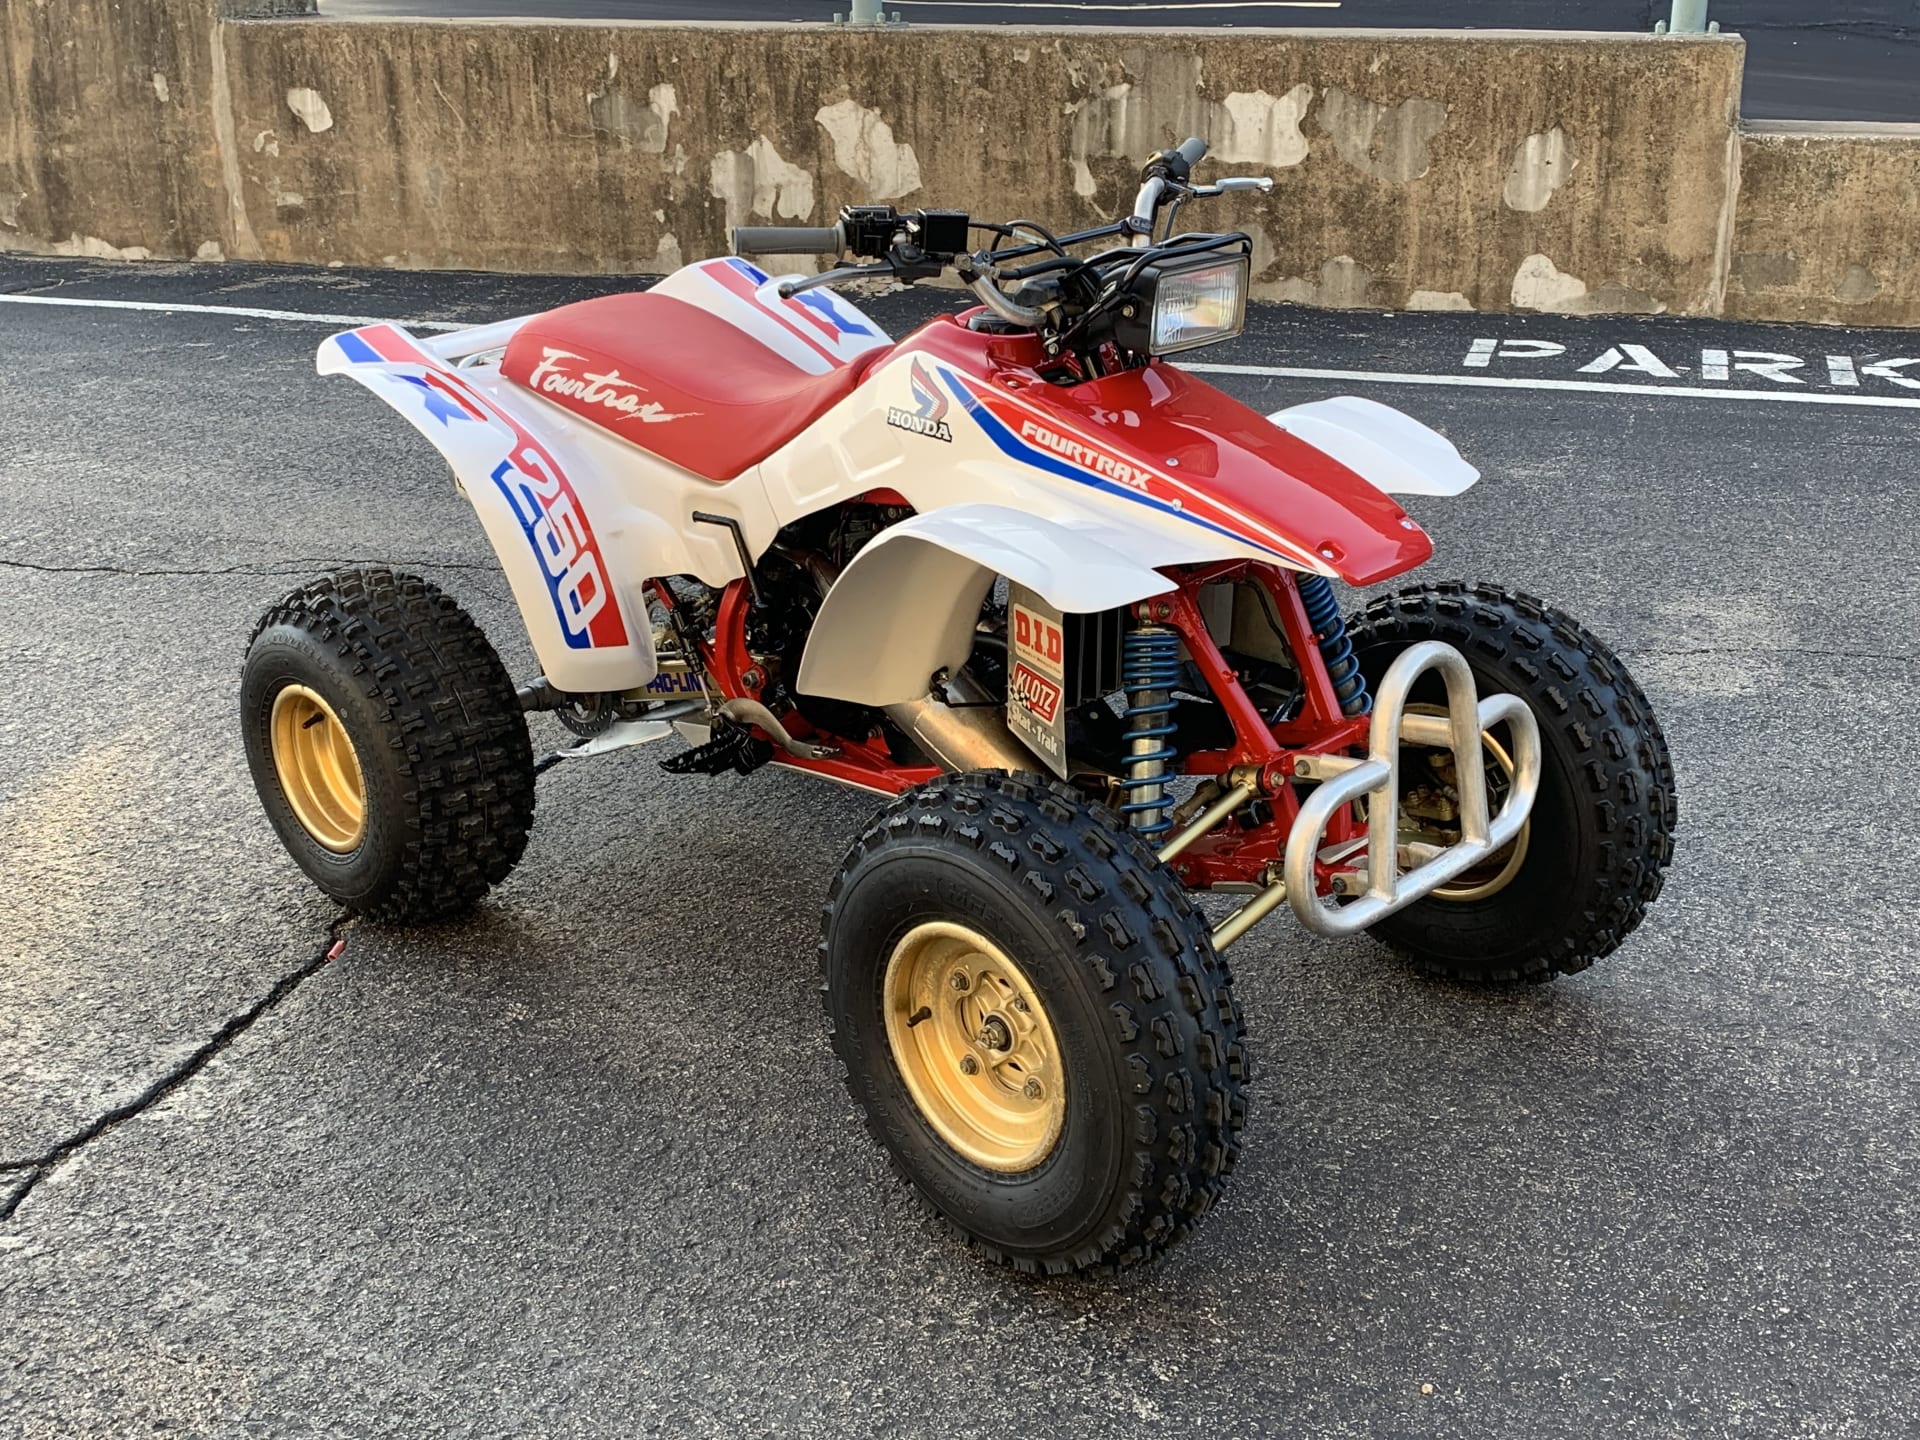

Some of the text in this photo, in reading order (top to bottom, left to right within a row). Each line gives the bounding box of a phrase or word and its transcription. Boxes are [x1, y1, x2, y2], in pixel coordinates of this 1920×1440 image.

[530, 346, 704, 423] Fourtrax
[887, 406, 952, 443] HONDA
[1020, 419, 1151, 491] FOURTRAX
[500, 447, 607, 636] 250
[1015, 669, 1057, 713] KLOTZ
